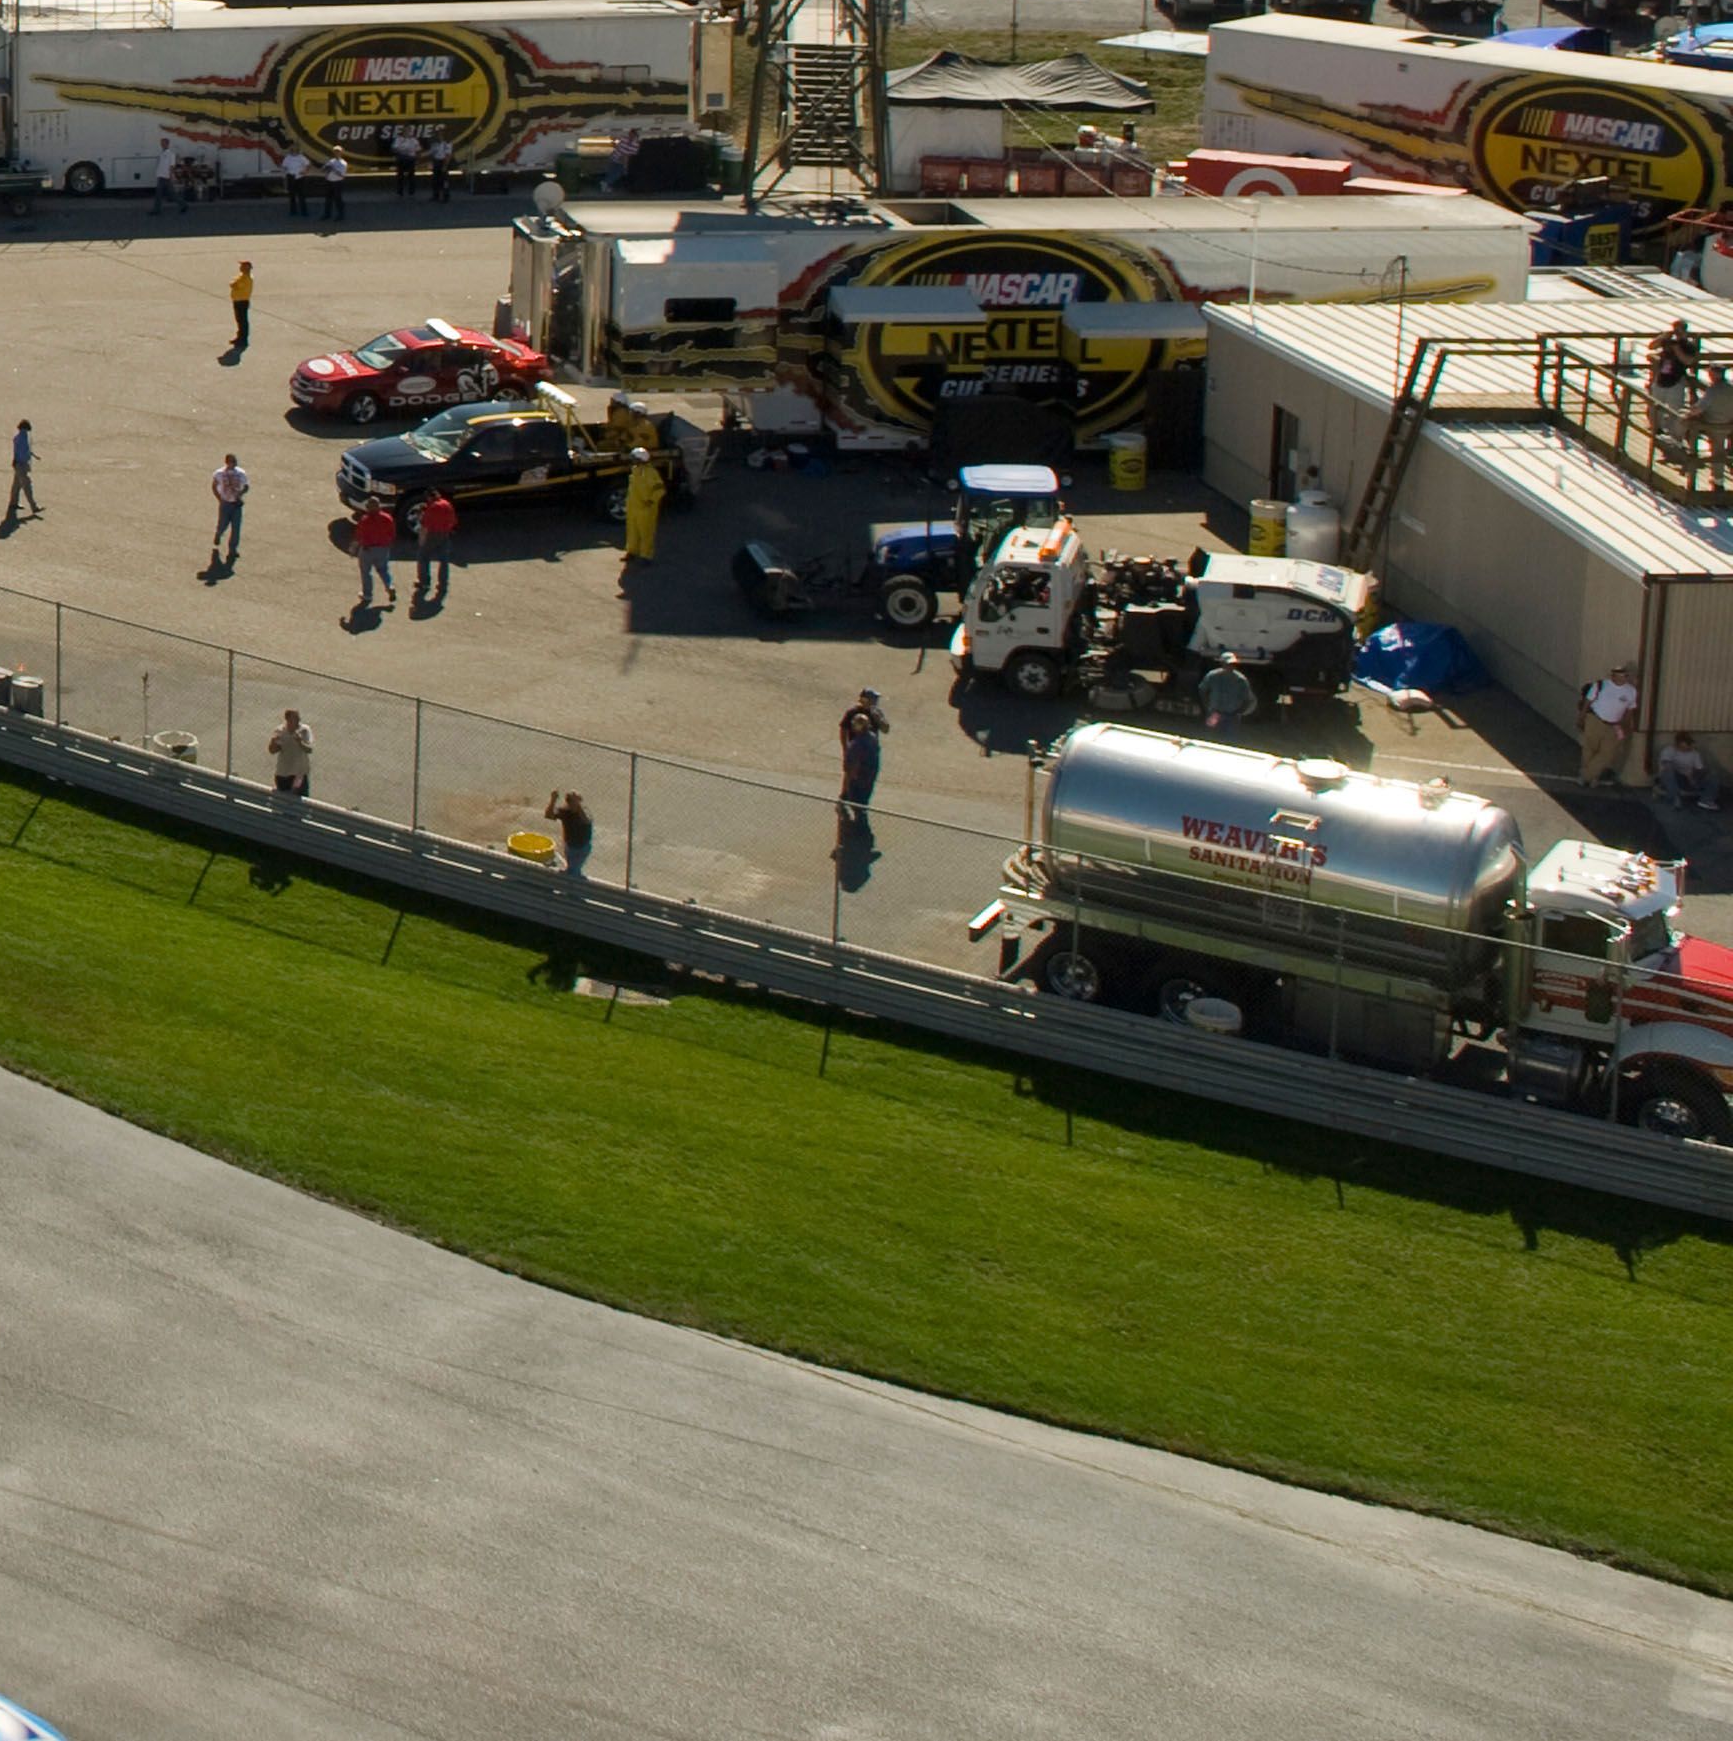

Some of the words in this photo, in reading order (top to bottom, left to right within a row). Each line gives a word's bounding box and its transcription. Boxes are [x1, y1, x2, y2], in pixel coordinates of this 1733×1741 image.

[364, 57, 449, 81] NASCAR
[328, 90, 454, 116] NEXTEL
[337, 124, 376, 141] CUP
[1562, 113, 1662, 150] NASCAR
[1520, 145, 1664, 192] NEXTEL
[1530, 185, 1559, 202] CU
[1588, 231, 1618, 248] BEST
[1589, 245, 1614, 261] BUY
[964, 272, 1081, 305] NASCAR
[929, 317, 1102, 365] NEXTEL
[389, 390, 478, 407] DODGE
[1287, 608, 1336, 623] DCM
[1181, 815, 1328, 867] WEAVER'S
